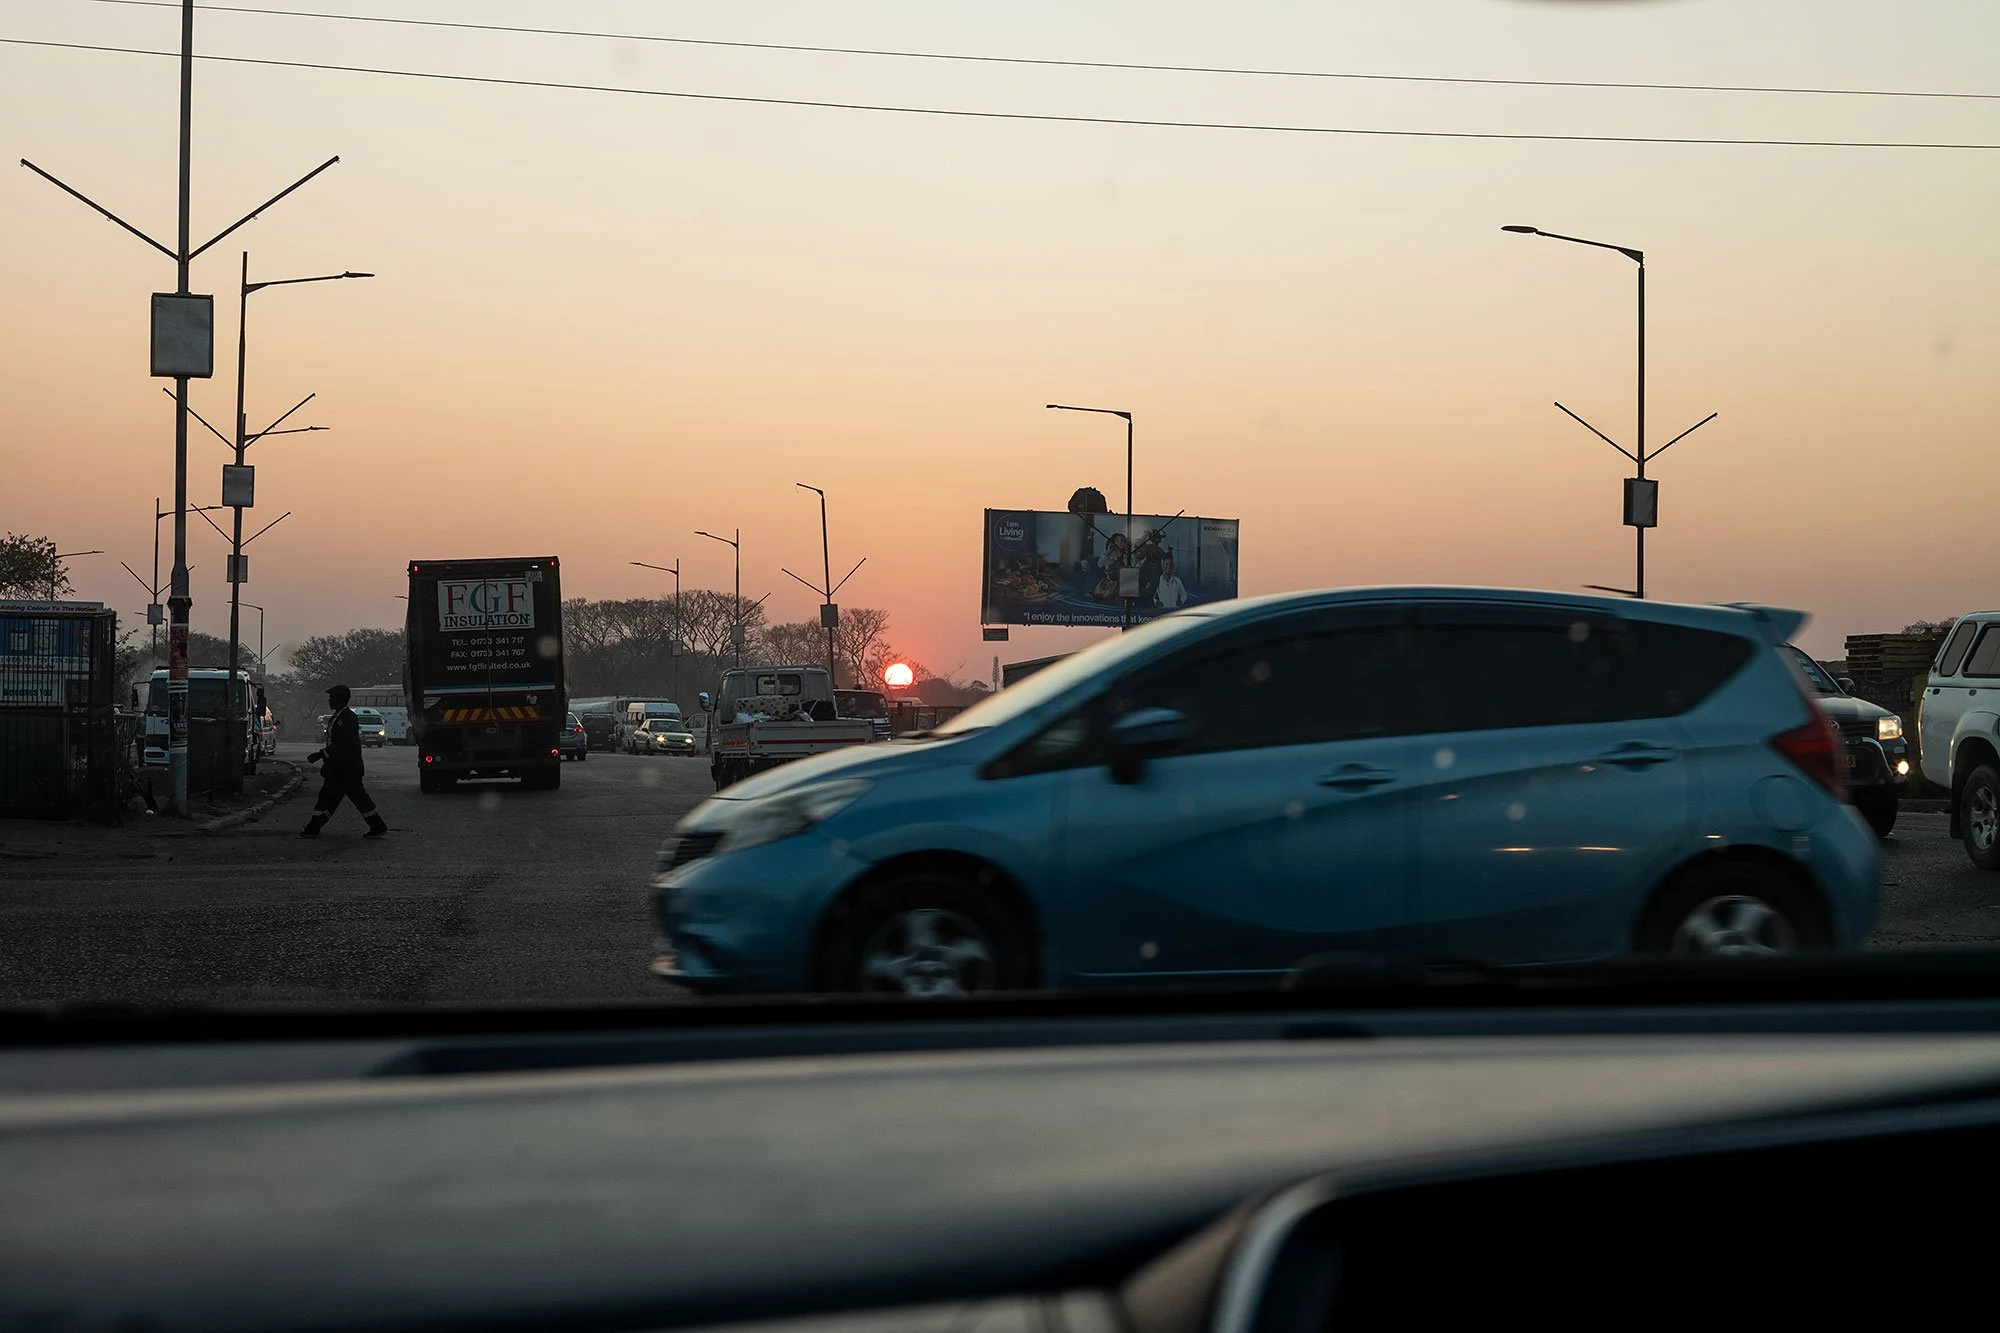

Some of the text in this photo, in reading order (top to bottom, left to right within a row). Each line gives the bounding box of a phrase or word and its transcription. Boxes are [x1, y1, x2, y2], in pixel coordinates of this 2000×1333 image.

[999, 527, 1024, 539] Living
[443, 583, 528, 615] FGF
[443, 613, 530, 627] INSULATION
[1031, 612, 1056, 622] enjoy
[1056, 613, 1070, 621] the
[1071, 613, 1120, 622] innovations
[470, 637, 493, 646] 01733
[496, 637, 510, 645] 341
[512, 636, 524, 644] 717
[451, 648, 525, 658] FAX: 01733 341 767
